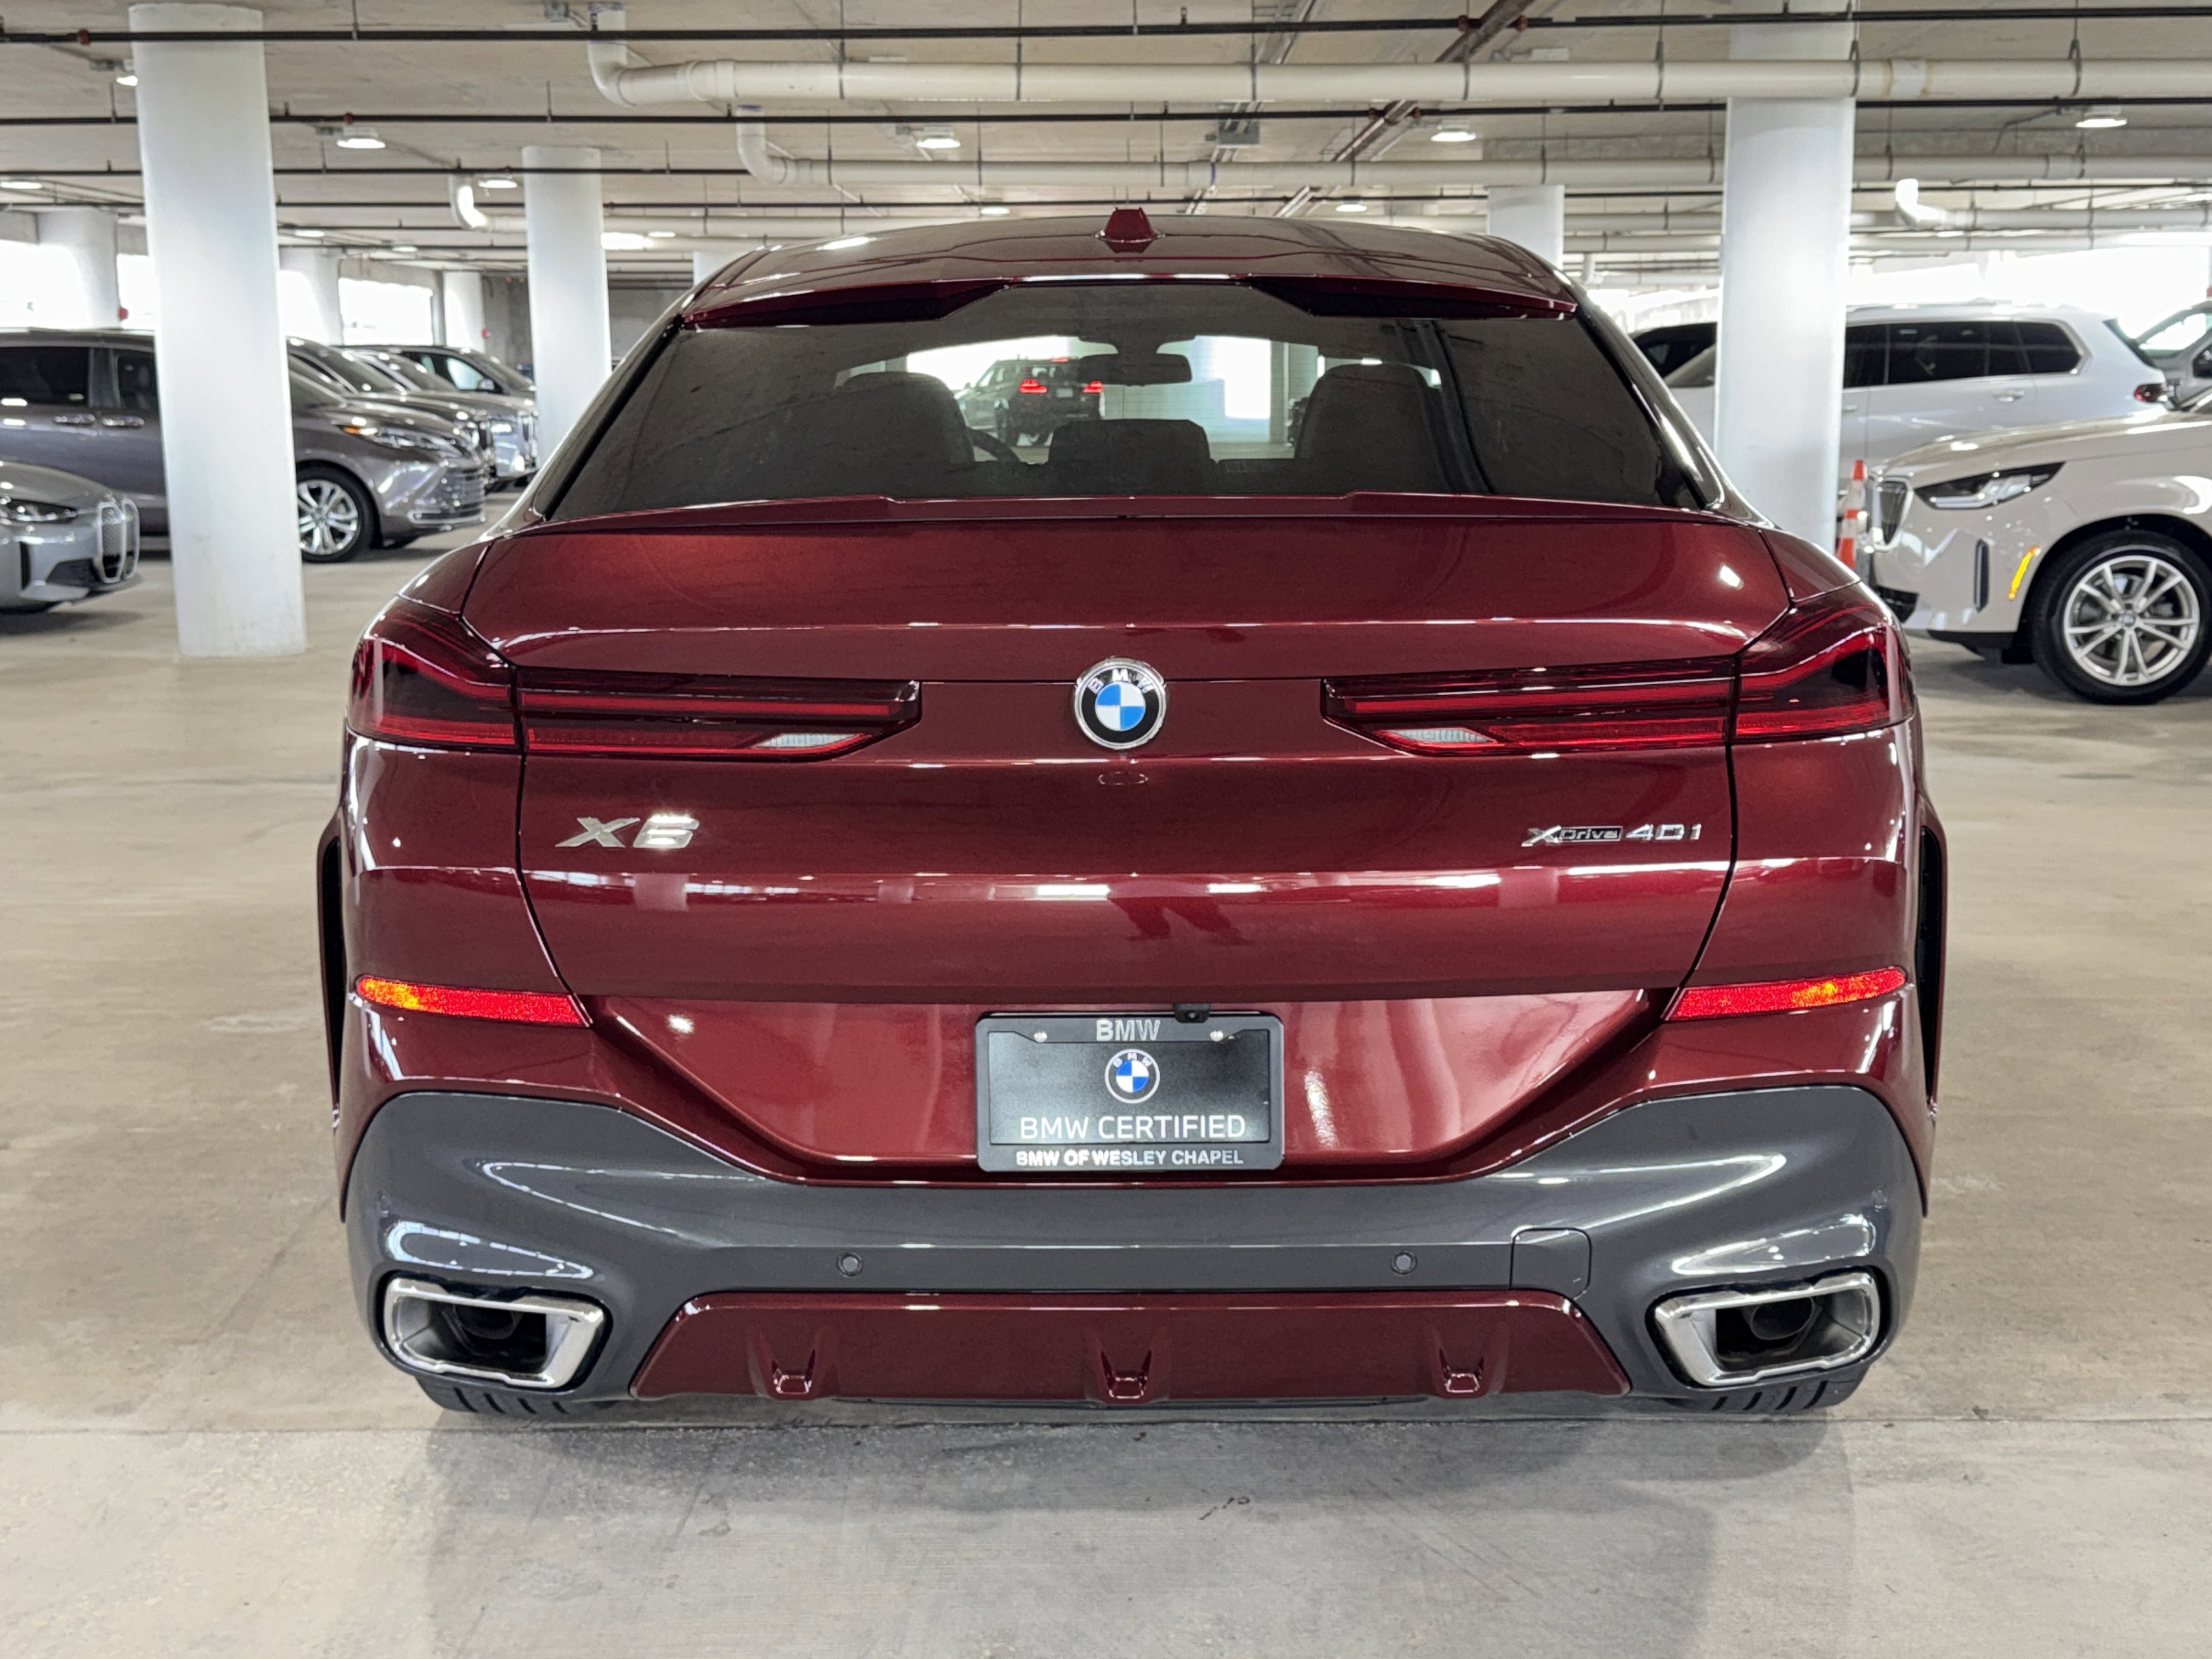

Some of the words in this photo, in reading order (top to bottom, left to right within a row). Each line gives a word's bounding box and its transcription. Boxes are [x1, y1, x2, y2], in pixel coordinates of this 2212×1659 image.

[1087, 668, 1154, 695] BMW
[555, 814, 700, 848] X6
[1096, 1019, 1161, 1042] BMW
[1113, 1052, 1153, 1068] BMW
[1020, 1116, 1090, 1139] BMW
[1098, 1115, 1246, 1139] CERTIFIED
[1016, 1150, 1060, 1166] BMW
[1063, 1150, 1090, 1166] OF
[1092, 1150, 1166, 1166] WESLEY
[1171, 1150, 1244, 1165] CHAPEL
